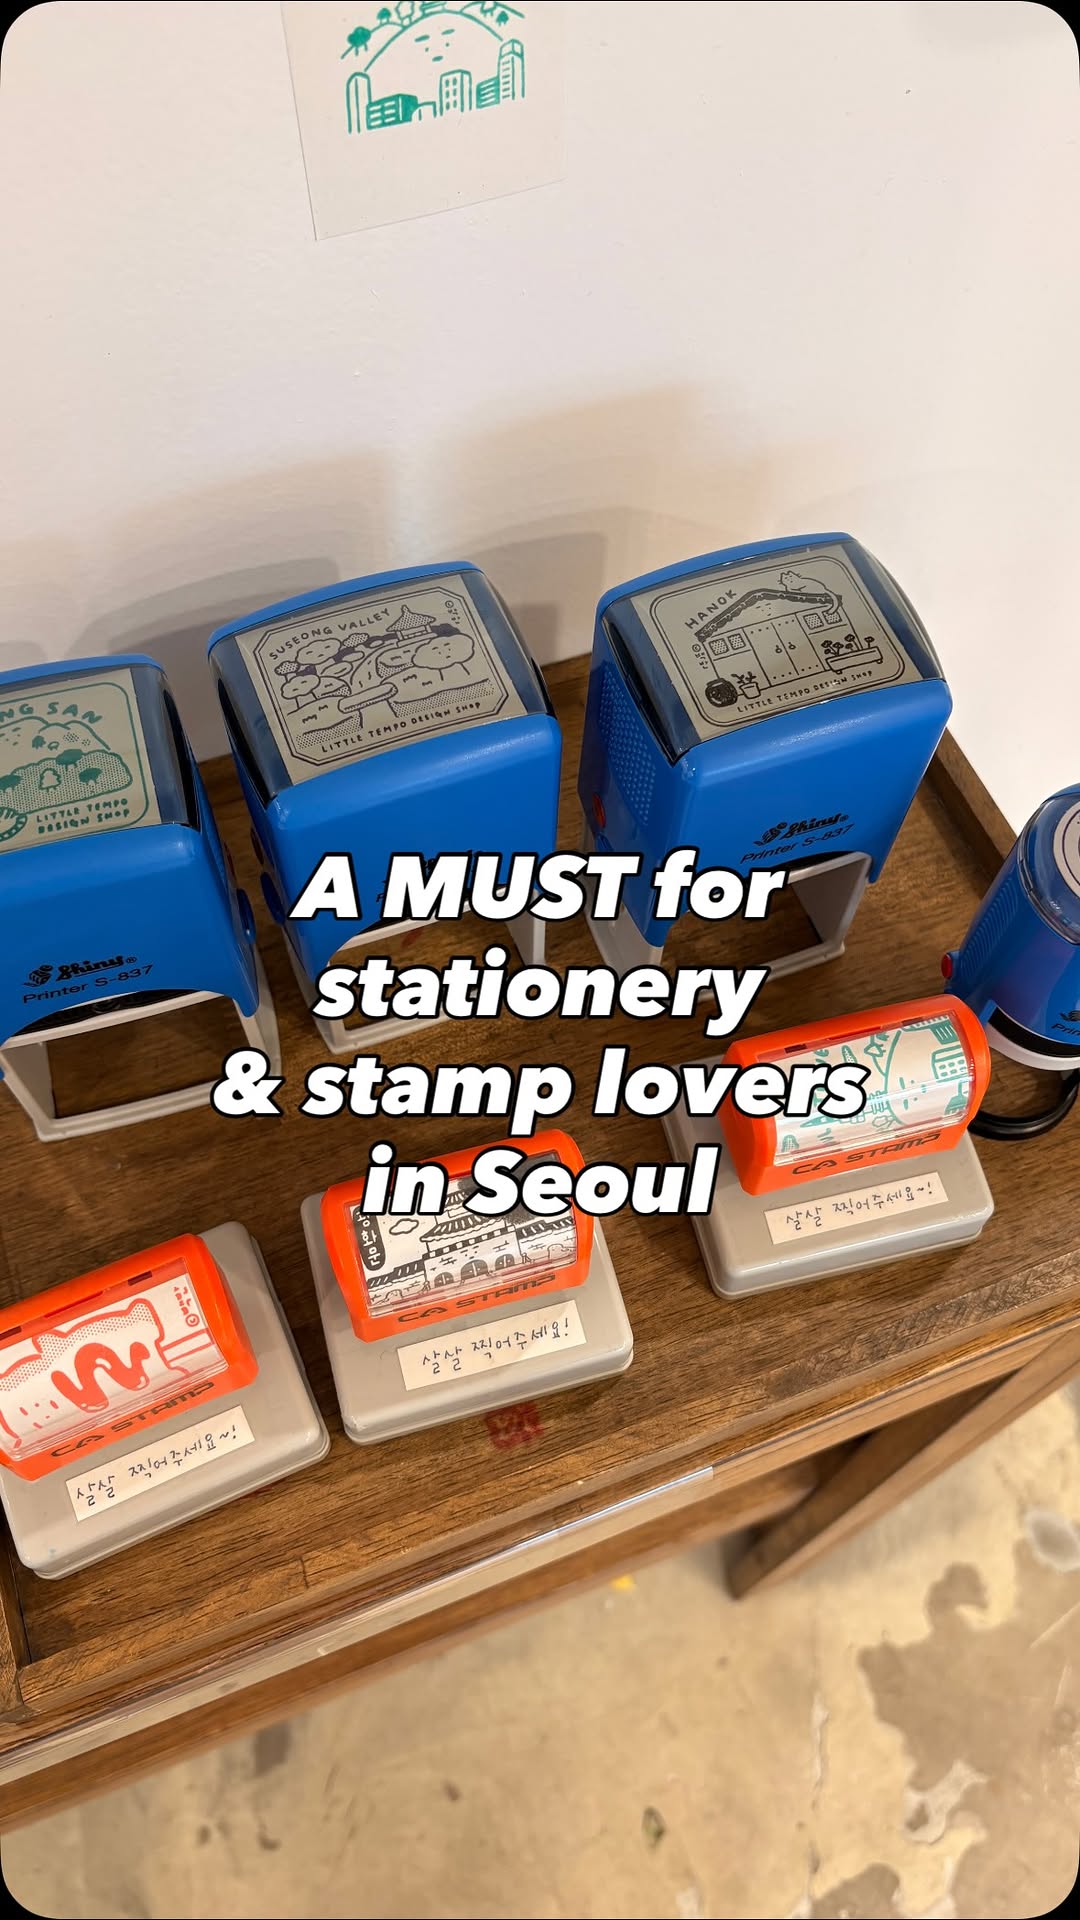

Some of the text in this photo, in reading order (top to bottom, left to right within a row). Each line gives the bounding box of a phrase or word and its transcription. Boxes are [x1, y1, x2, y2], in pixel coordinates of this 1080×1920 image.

[684, 589, 737, 629] HANOK
[269, 607, 390, 661] SUSEONG VALLEY
[736, 670, 873, 713] LITTLE TEMPO DESIGN SHOP
[46, 702, 102, 724] SAN
[321, 700, 482, 753] LITTLE TEMPO DESIGN SHOP
[36, 798, 129, 823] LITTLE TEMPO
[38, 808, 131, 834] DESIGN SHOP
[740, 824, 854, 864] Printer S-837
[22, 964, 154, 1004] Printer S-837
[792, 1130, 941, 1176] CA STAMP
[786, 1207, 823, 1231] 살살
[397, 1273, 556, 1324] CA STAMP
[422, 1345, 463, 1375] 살살
[50, 1379, 215, 1458] CA STAMP
[76, 1474, 116, 1507] 살살
